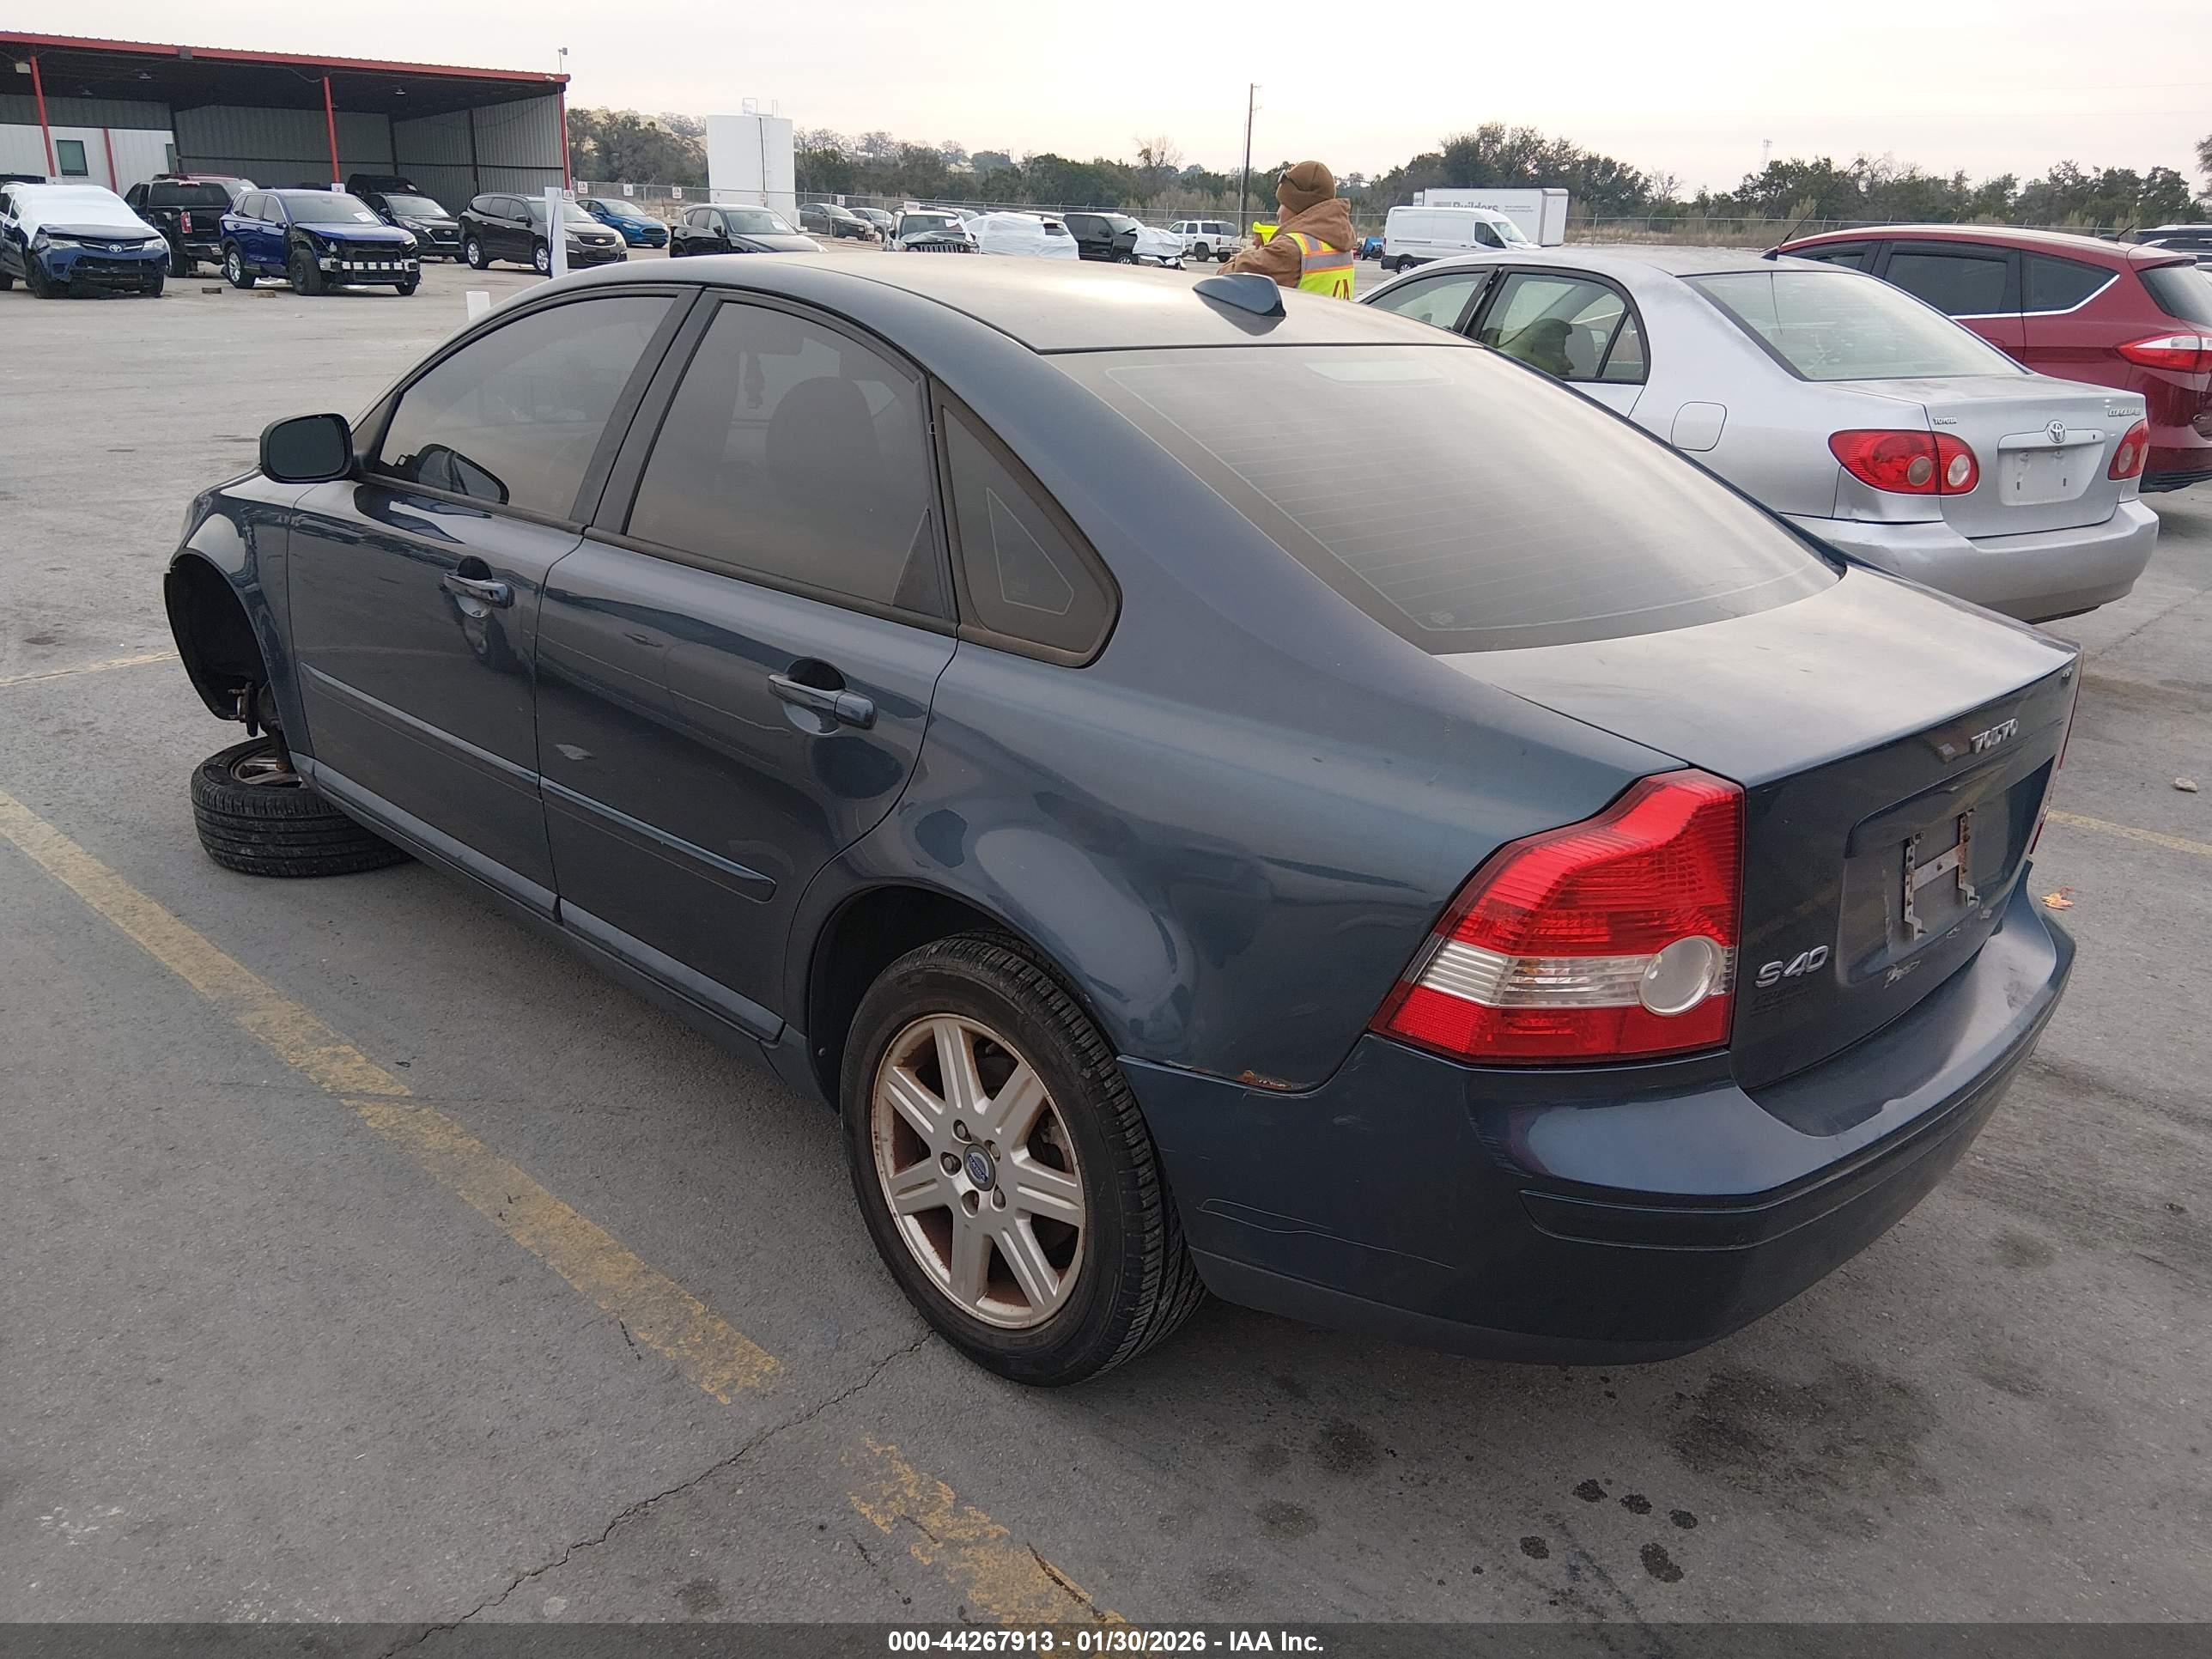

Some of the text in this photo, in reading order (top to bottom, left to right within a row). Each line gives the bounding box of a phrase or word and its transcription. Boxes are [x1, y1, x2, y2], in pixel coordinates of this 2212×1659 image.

[1933, 416, 1957, 425] TOYOTA
[1972, 718, 2019, 754] VOLVO
[1755, 945, 1828, 988] S40
